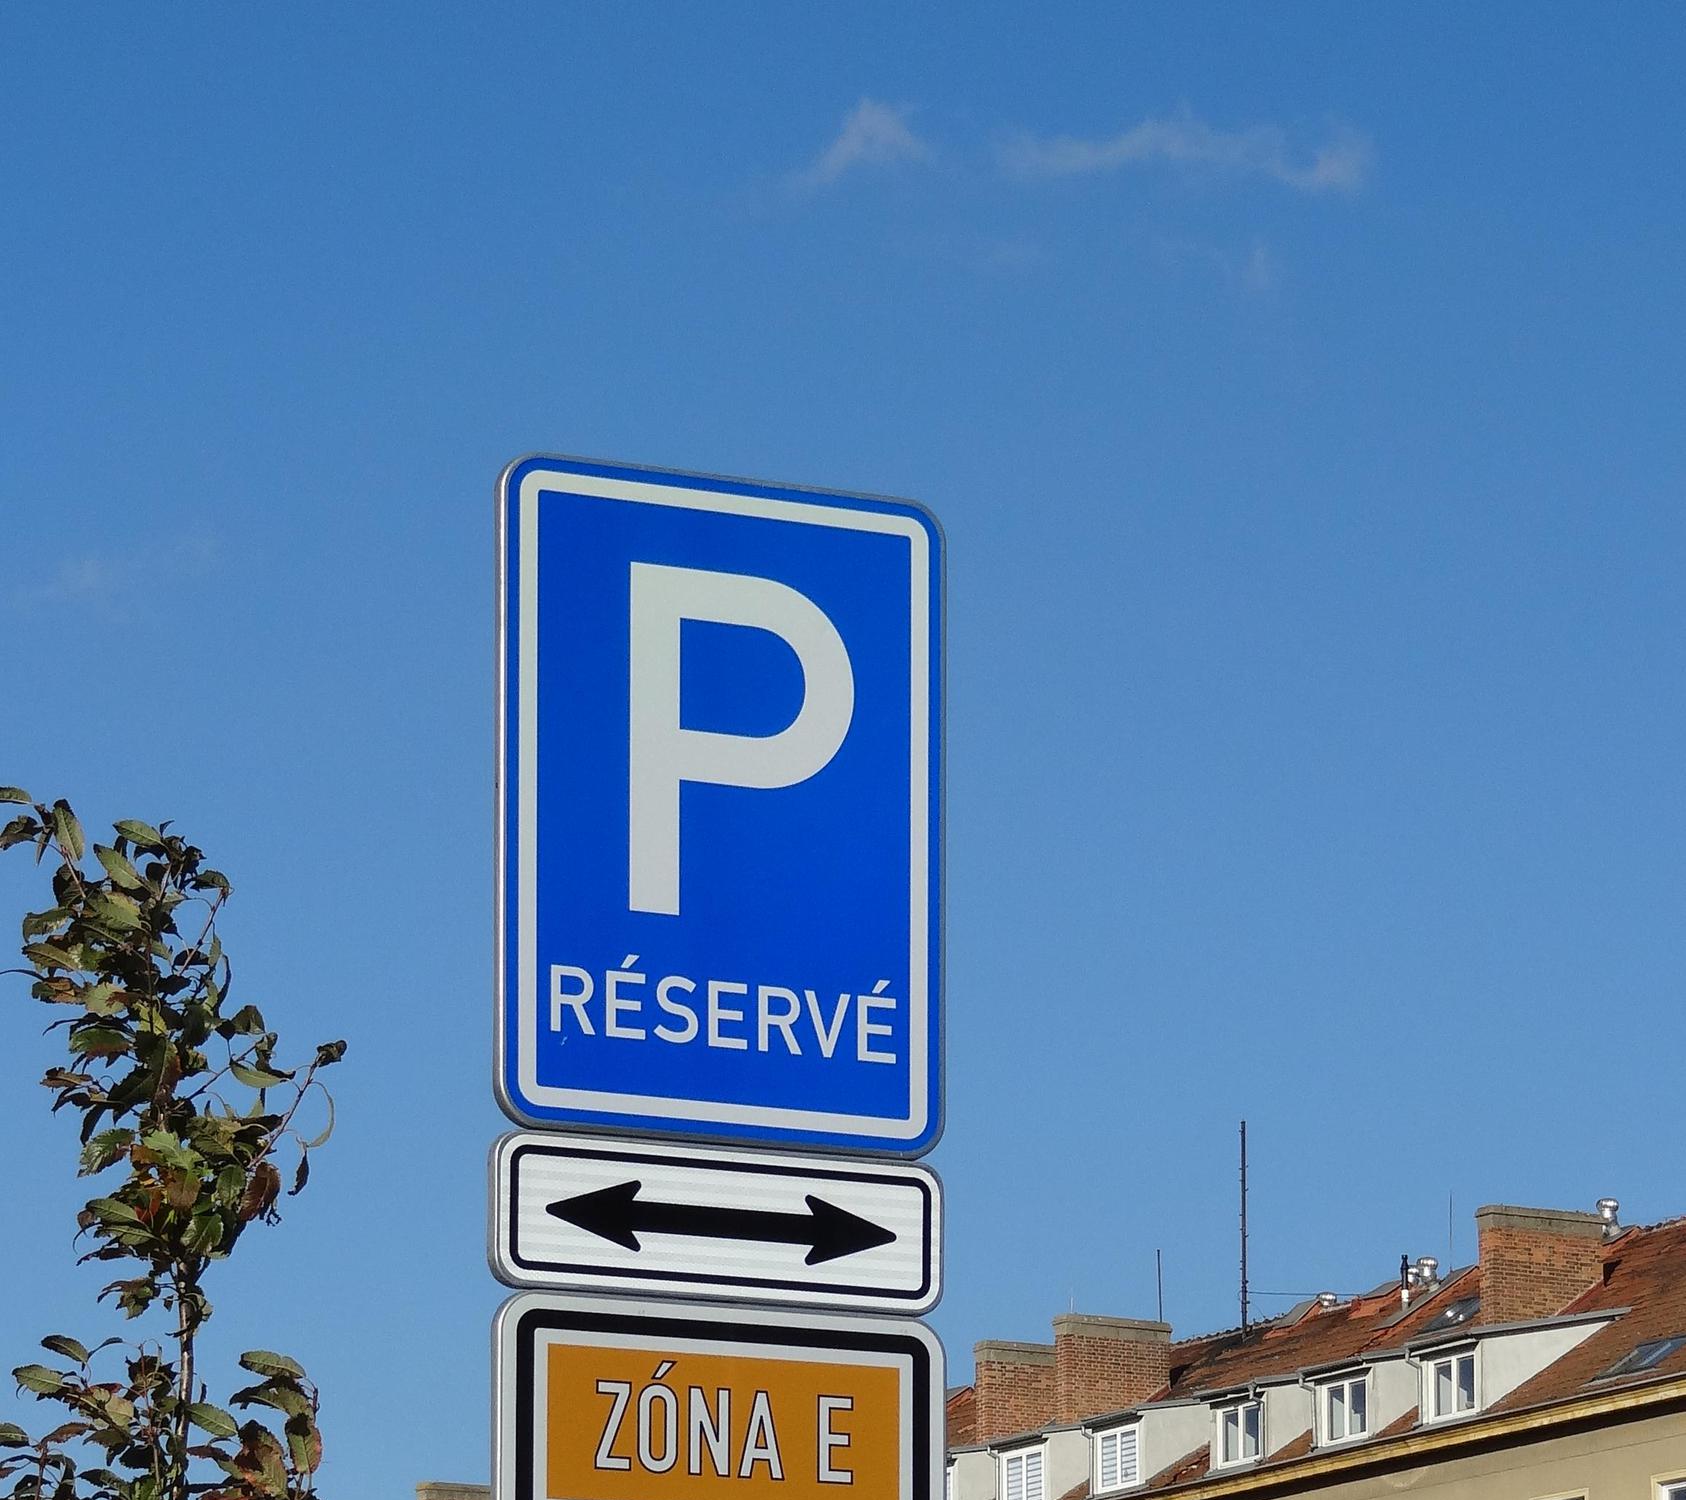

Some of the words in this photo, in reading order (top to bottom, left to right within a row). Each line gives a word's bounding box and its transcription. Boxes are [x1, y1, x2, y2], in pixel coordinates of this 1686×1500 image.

[629, 561, 855, 916] P
[550, 954, 897, 1064] RÉSERVÉ
[594, 1360, 784, 1481] ZÓNA
[817, 1394, 854, 1485] E
